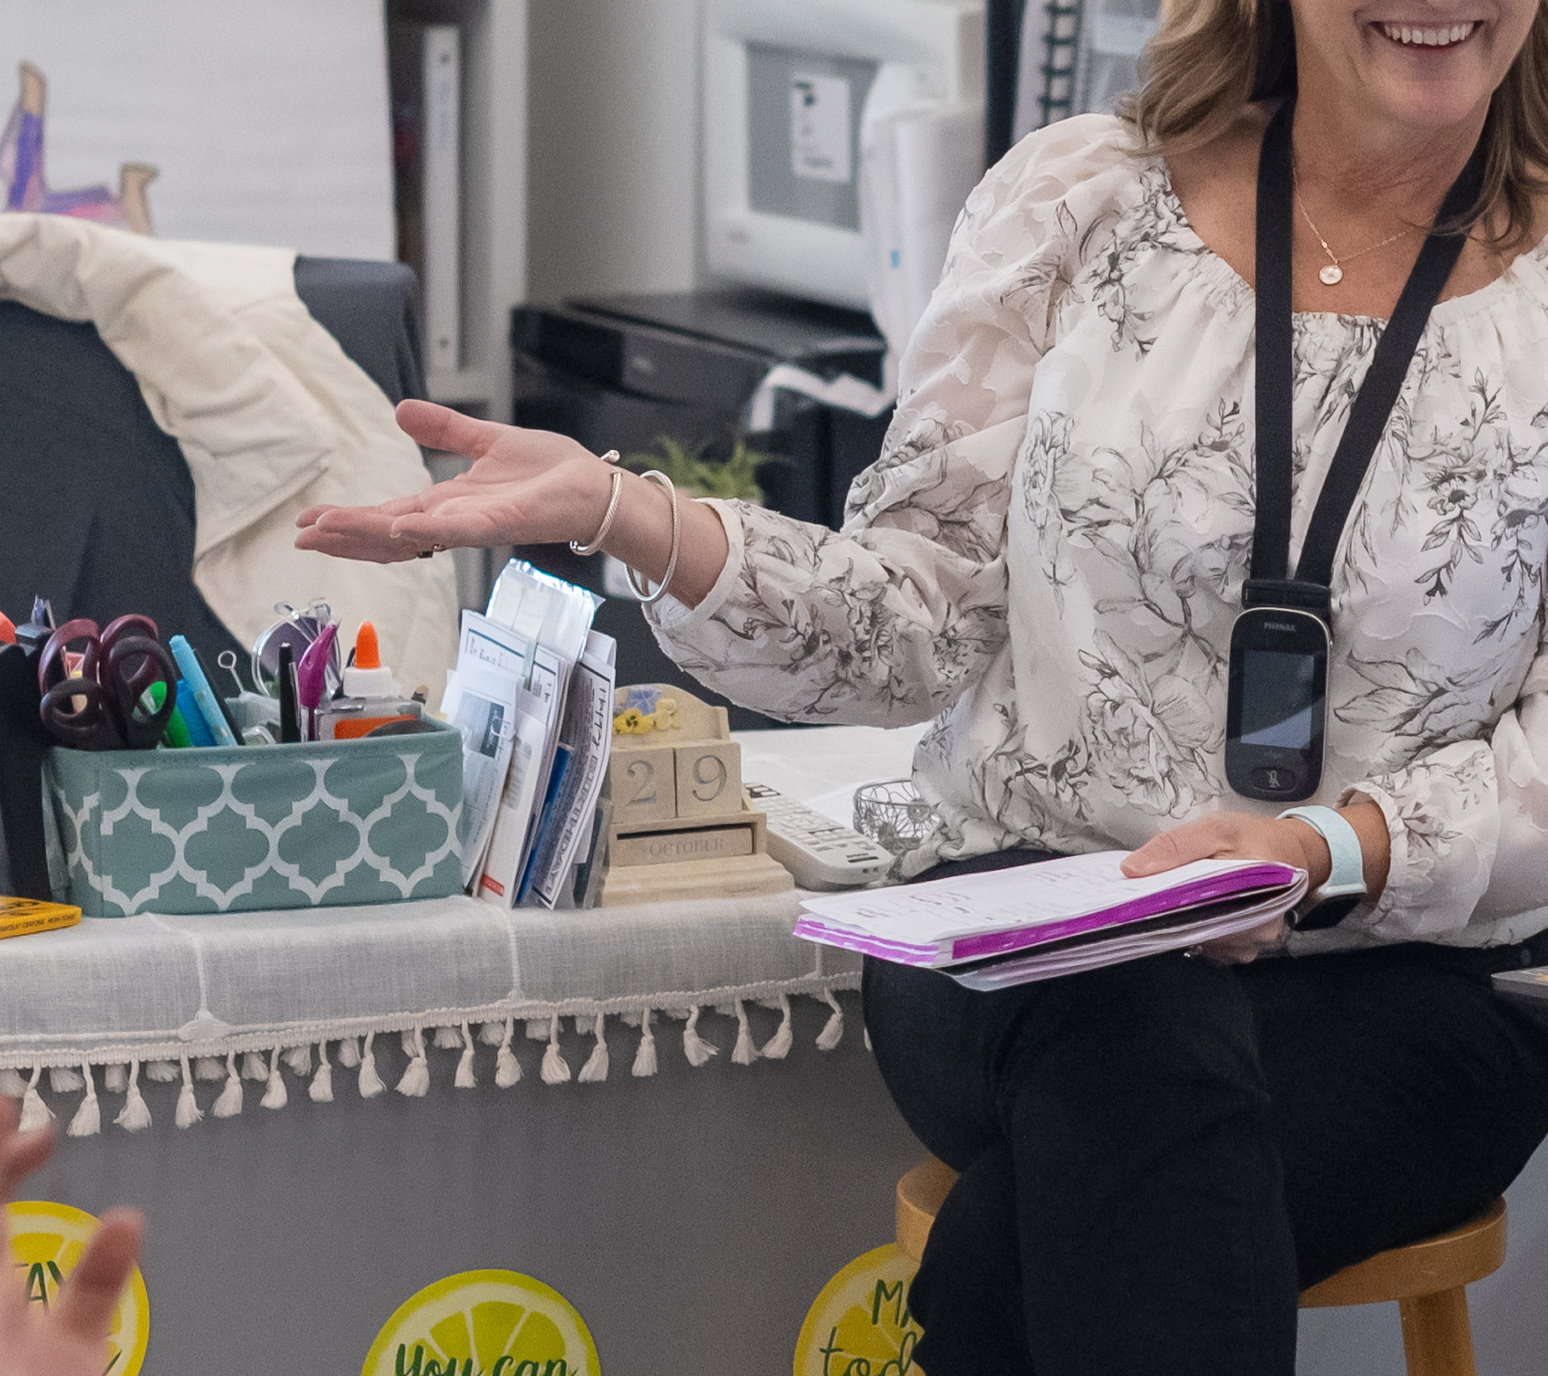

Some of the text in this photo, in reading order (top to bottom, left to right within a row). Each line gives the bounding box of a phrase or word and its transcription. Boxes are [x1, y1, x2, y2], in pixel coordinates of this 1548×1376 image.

[1264, 621, 1297, 632] PHONAK
[627, 754, 727, 804] 2 9
[648, 835, 726, 857] OCTOBER
